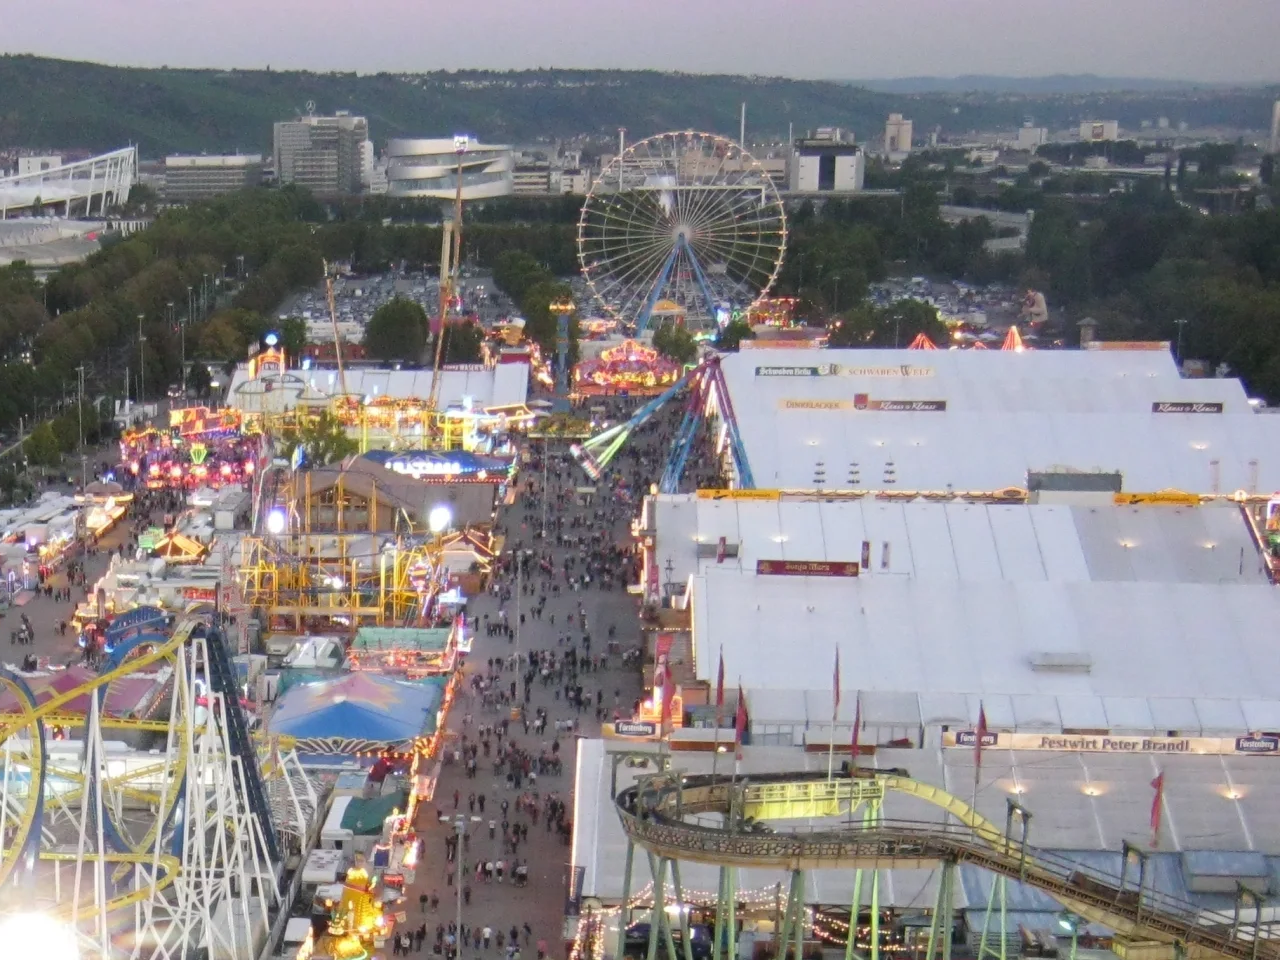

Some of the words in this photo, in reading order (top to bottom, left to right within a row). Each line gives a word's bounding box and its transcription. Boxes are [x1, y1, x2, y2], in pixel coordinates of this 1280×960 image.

[848, 367, 900, 376] SCHWABEN
[785, 400, 840, 409] DINKELACKER
[1039, 736, 1098, 749] Festwirt
[1102, 738, 1139, 750] Peter
[1142, 739, 1190, 751] Brandl
